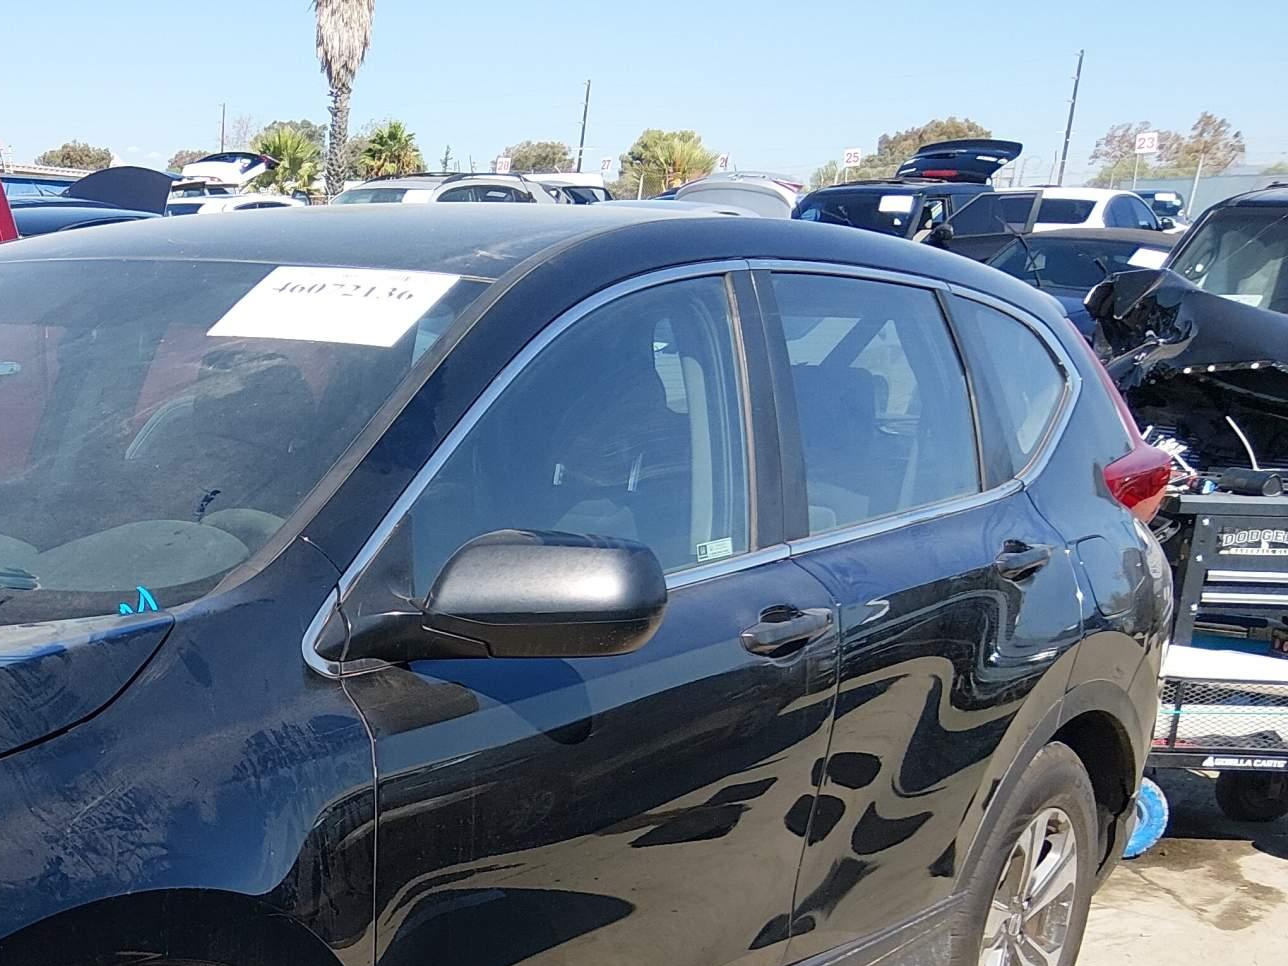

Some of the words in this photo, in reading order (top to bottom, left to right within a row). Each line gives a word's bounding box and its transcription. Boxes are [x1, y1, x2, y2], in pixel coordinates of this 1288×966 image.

[1138, 137, 1155, 149] 23
[845, 152, 860, 163] 25
[601, 159, 611, 170] 27
